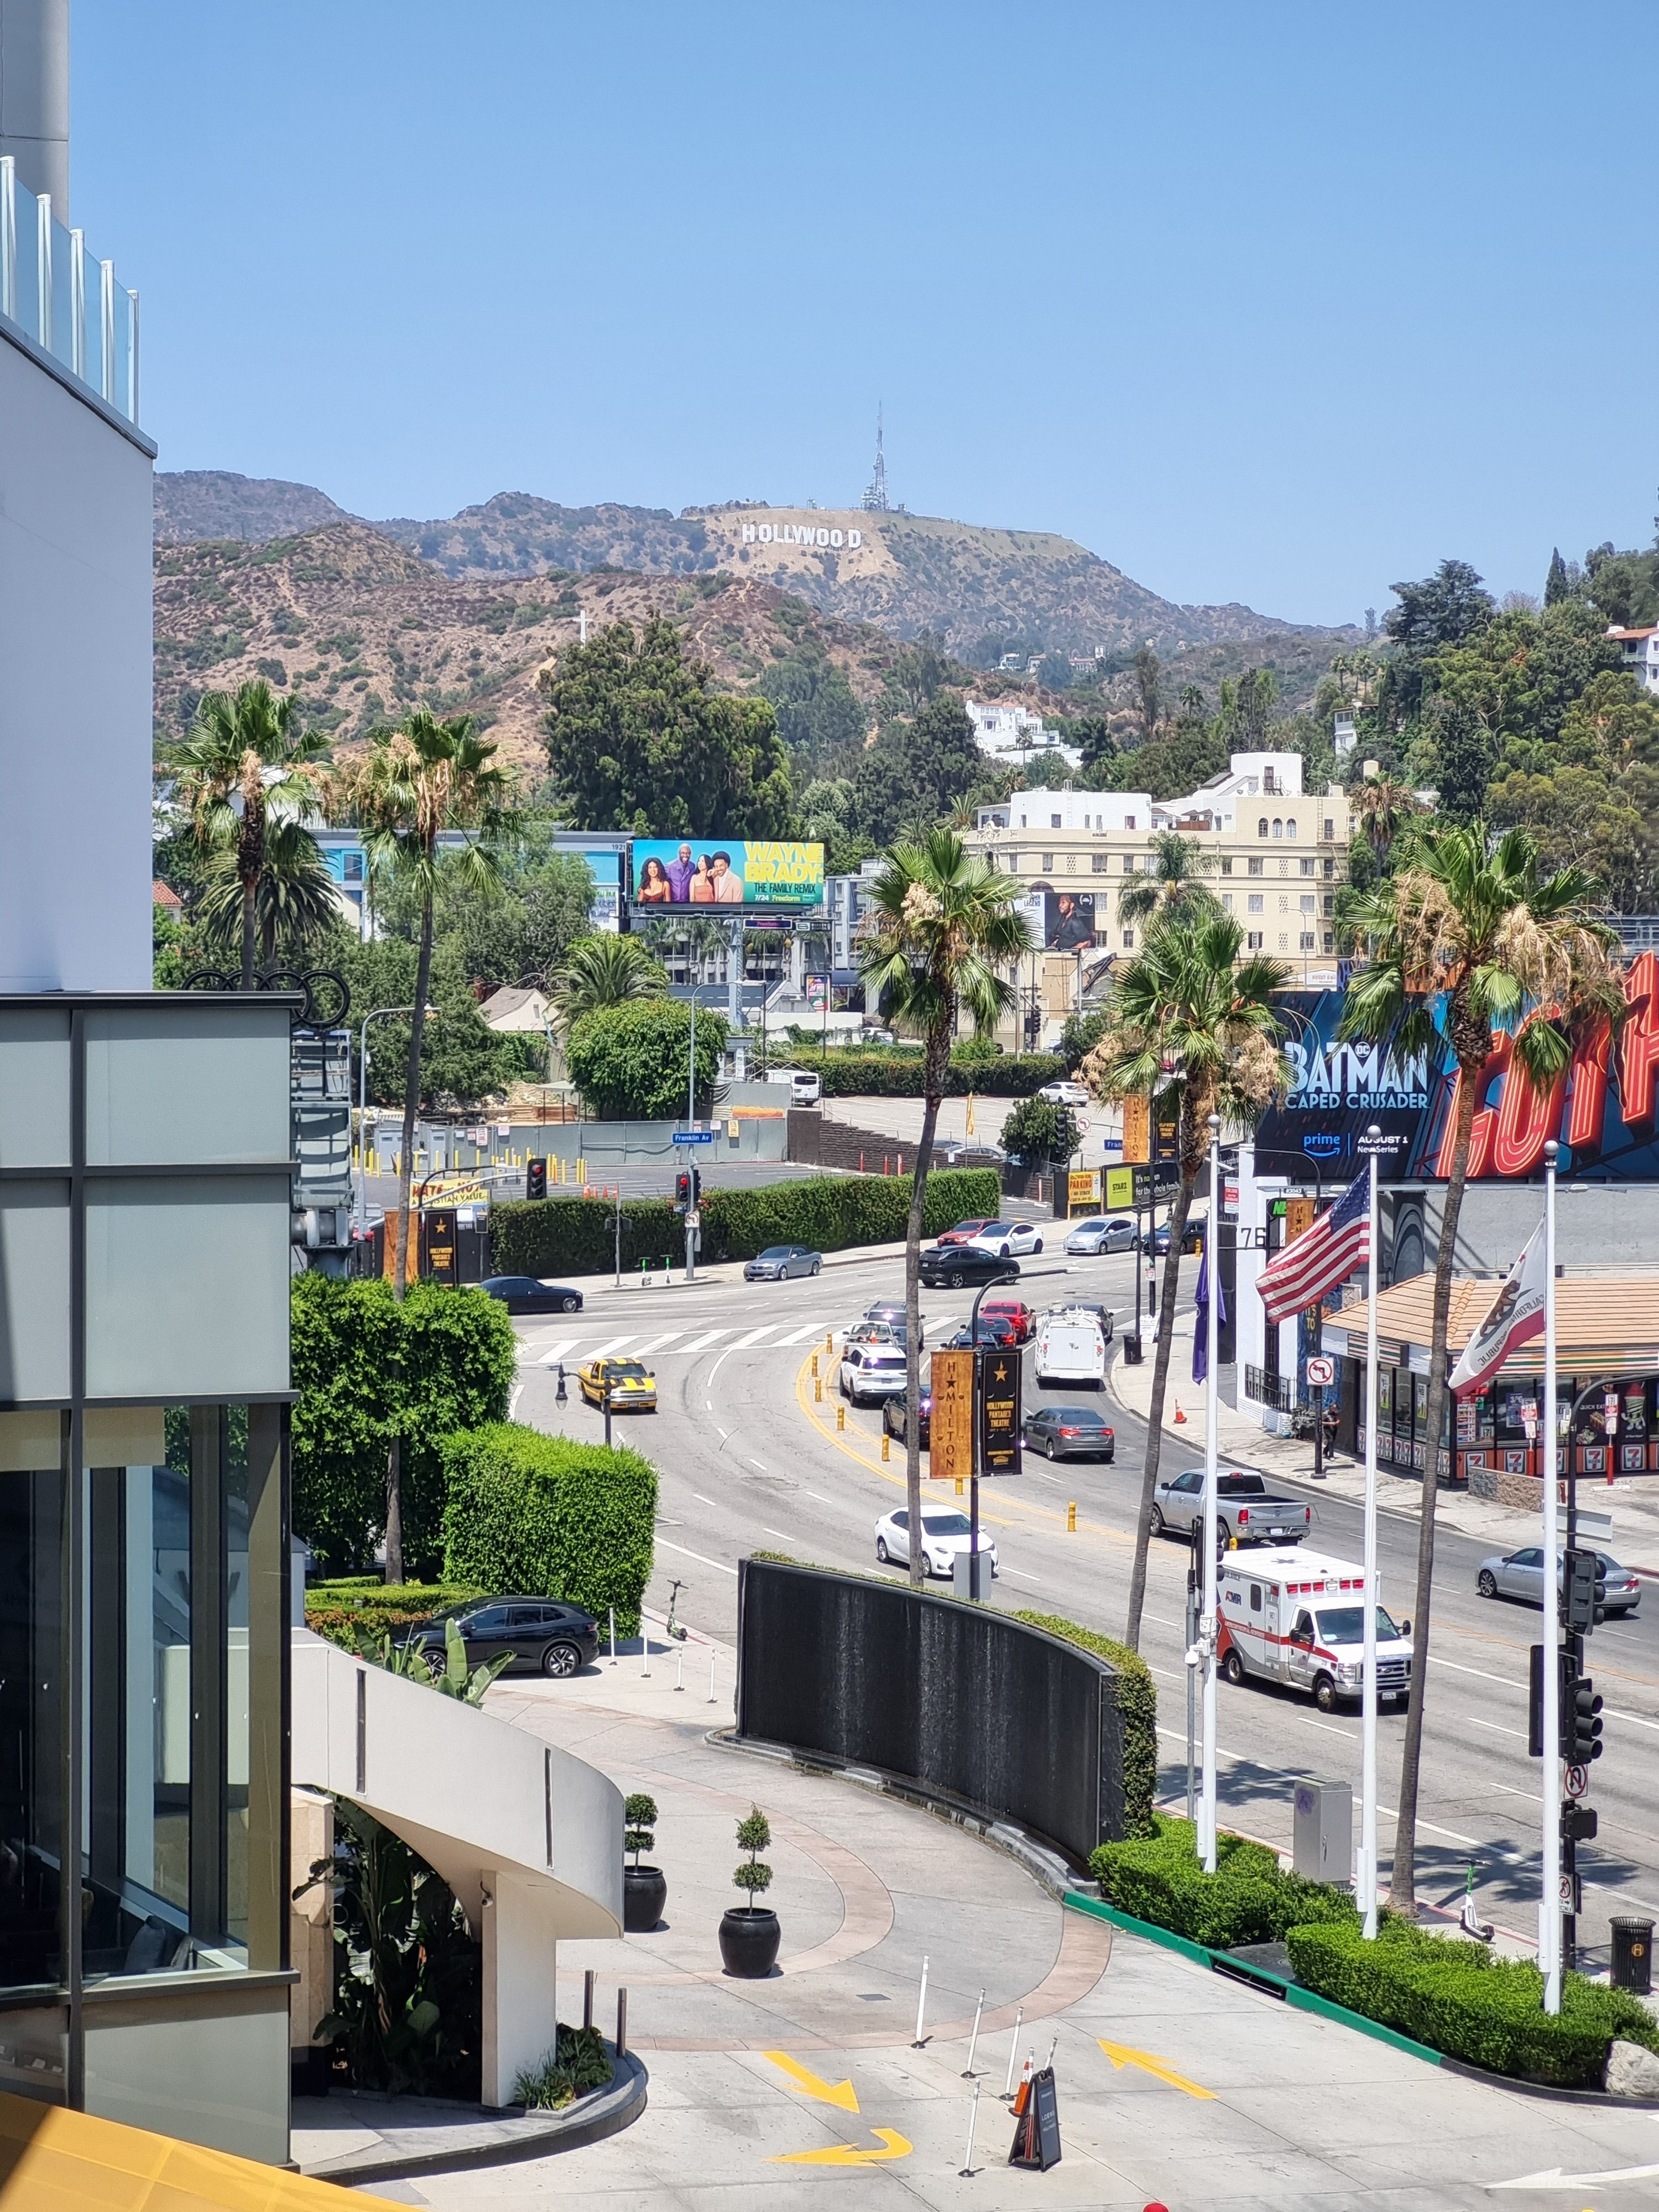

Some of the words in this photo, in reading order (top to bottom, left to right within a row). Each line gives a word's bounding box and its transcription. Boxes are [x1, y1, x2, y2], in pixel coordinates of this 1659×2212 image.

[742, 524, 861, 548] HOLLYWOOD
[744, 842, 824, 863] WAYNE
[745, 861, 824, 883] BRADY:
[755, 883, 767, 893] THE
[770, 883, 792, 893] FAMILY
[795, 884, 816, 894] REMIX
[1285, 1041, 1427, 1093] BATMAN
[1284, 1093, 1340, 1109] CAPED
[1346, 1093, 1429, 1109] CRUSADER
[1304, 1133, 1340, 1147] prime
[1112, 1182, 1128, 1191] STARZ
